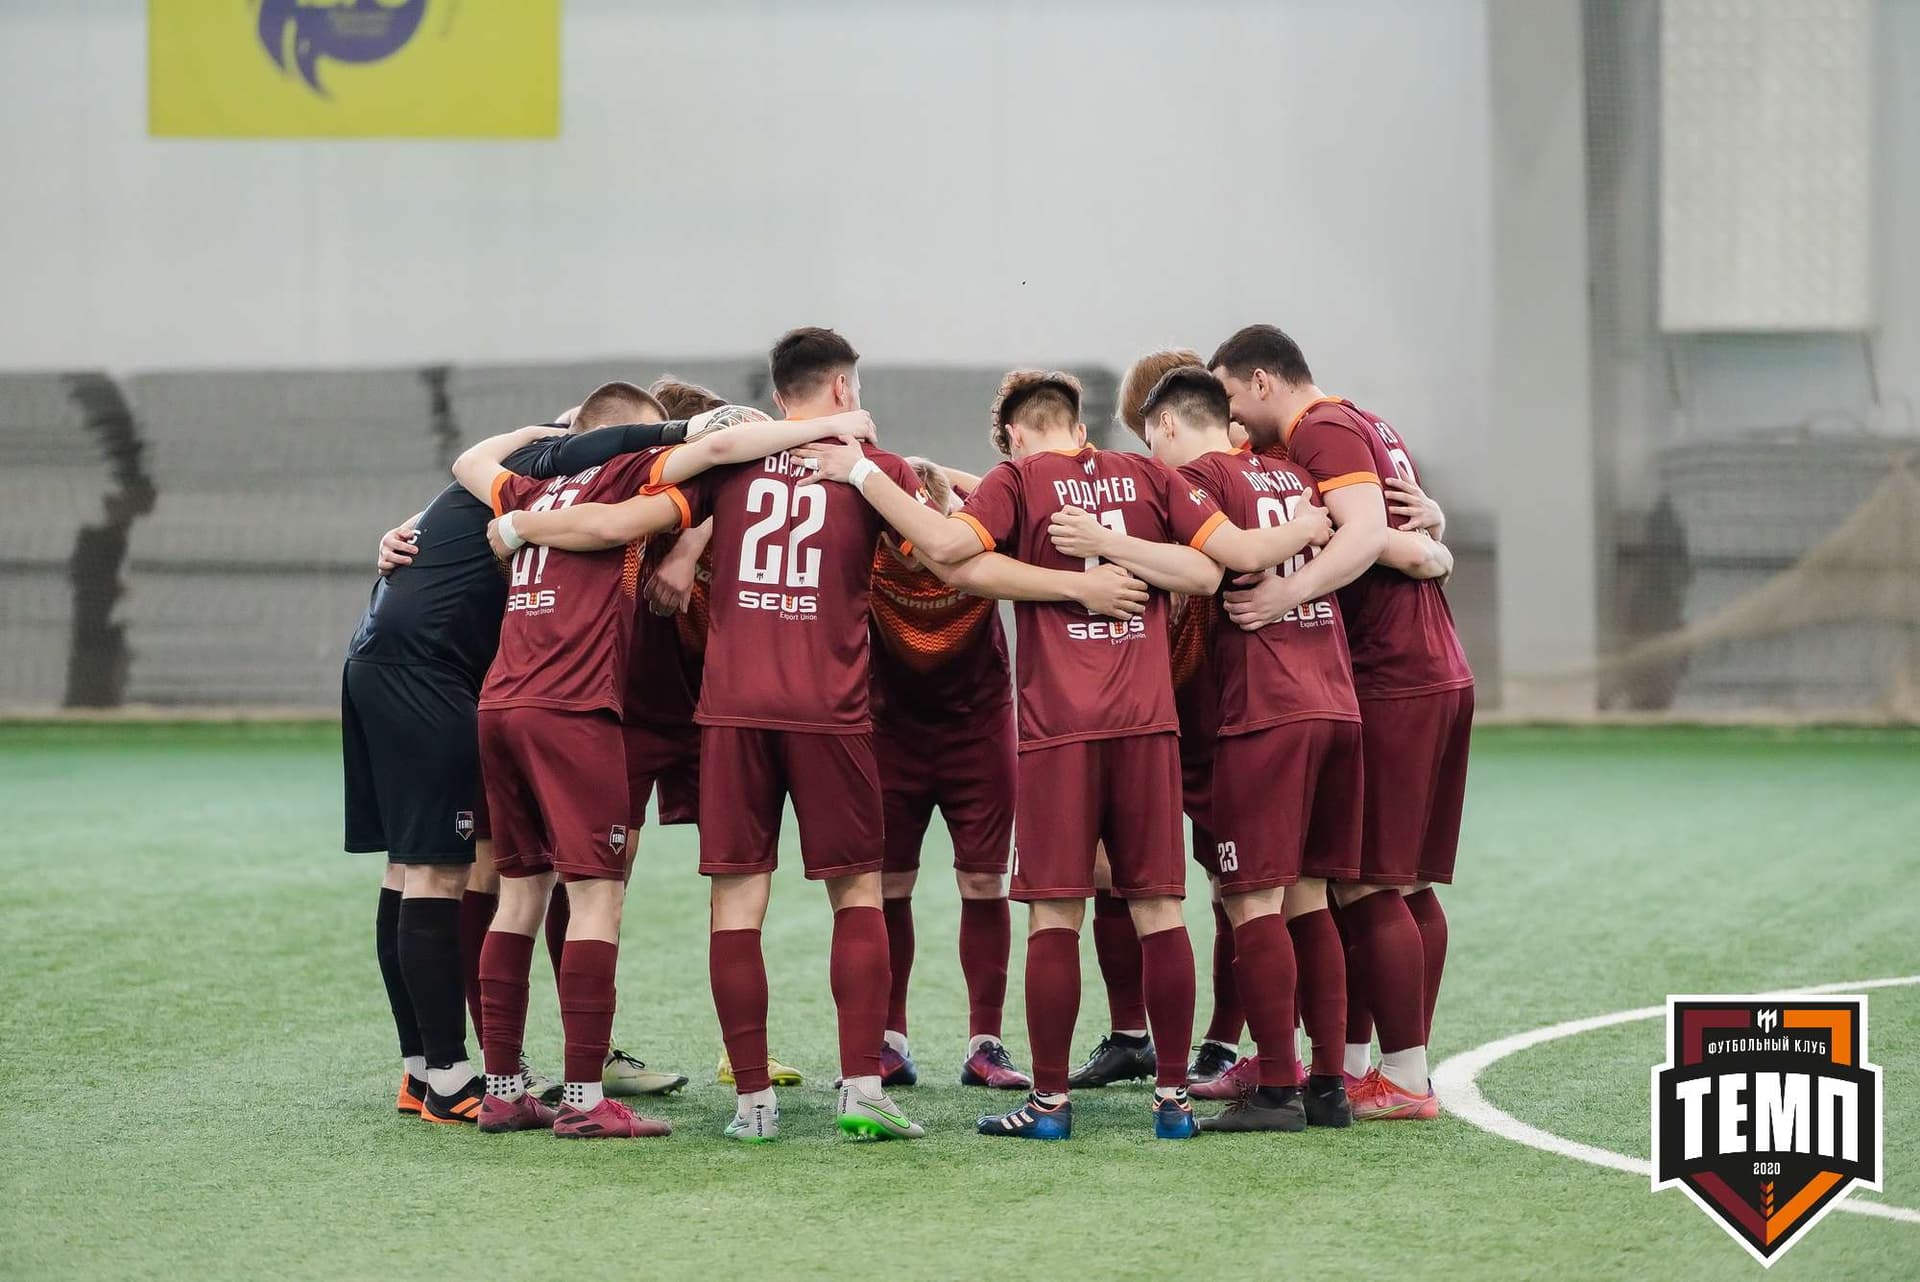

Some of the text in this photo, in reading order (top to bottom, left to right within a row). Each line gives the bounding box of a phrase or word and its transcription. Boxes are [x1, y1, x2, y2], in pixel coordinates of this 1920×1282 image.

[738, 477, 827, 588] 22
[738, 590, 817, 613] SEUS
[1272, 601, 1334, 622] EUS
[1067, 616, 1145, 640] SEUS
[1218, 841, 1238, 872] 23
